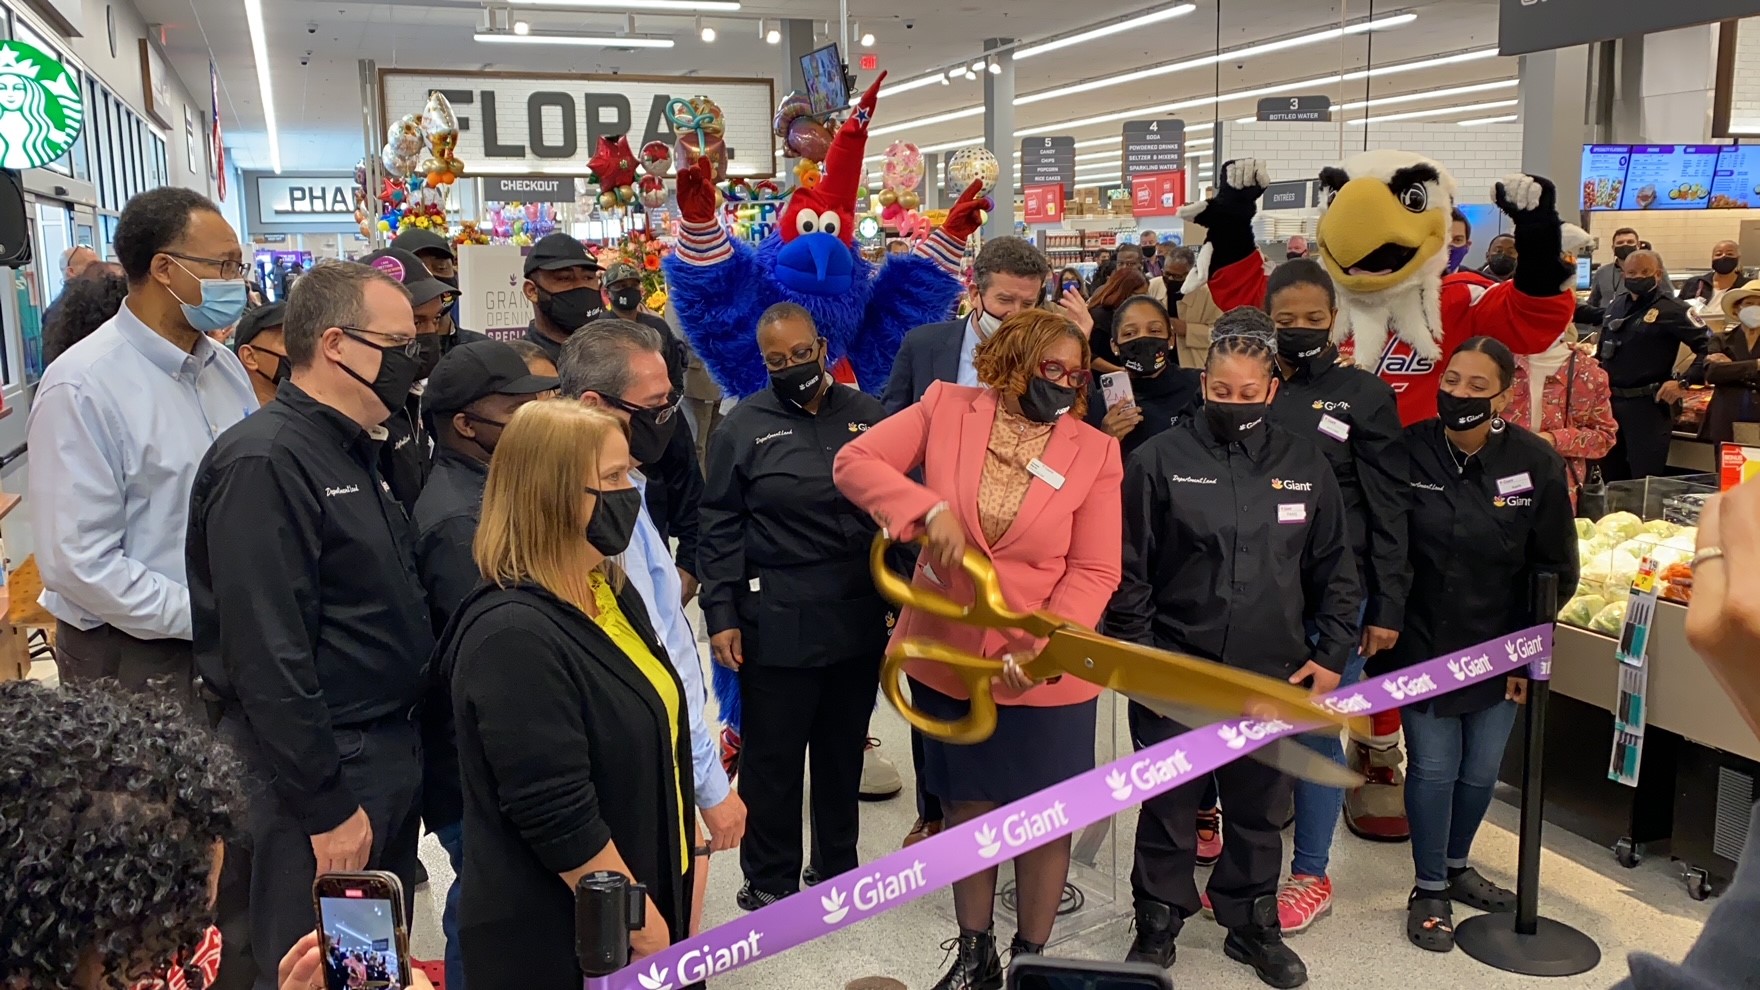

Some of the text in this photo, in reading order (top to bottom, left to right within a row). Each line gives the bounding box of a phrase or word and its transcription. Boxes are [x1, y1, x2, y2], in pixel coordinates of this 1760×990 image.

[1290, 98, 1298, 110] 3
[428, 90, 734, 160] FLORA
[1149, 121, 1158, 132] 4
[1044, 137, 1052, 147] 5
[500, 179, 559, 192] CHECKOUT
[485, 290, 530, 310] GRAN
[486, 311, 533, 326] OPENIN
[1283, 480, 1312, 491] Giant
[1506, 495, 1532, 507] Giant
[1516, 634, 1544, 659] Giant
[1461, 653, 1494, 678] Giant
[1397, 672, 1438, 696] Giant
[1130, 748, 1193, 791] Giant
[1002, 799, 1070, 848] Giant
[853, 859, 927, 911] Giant
[676, 929, 765, 987] Giant
